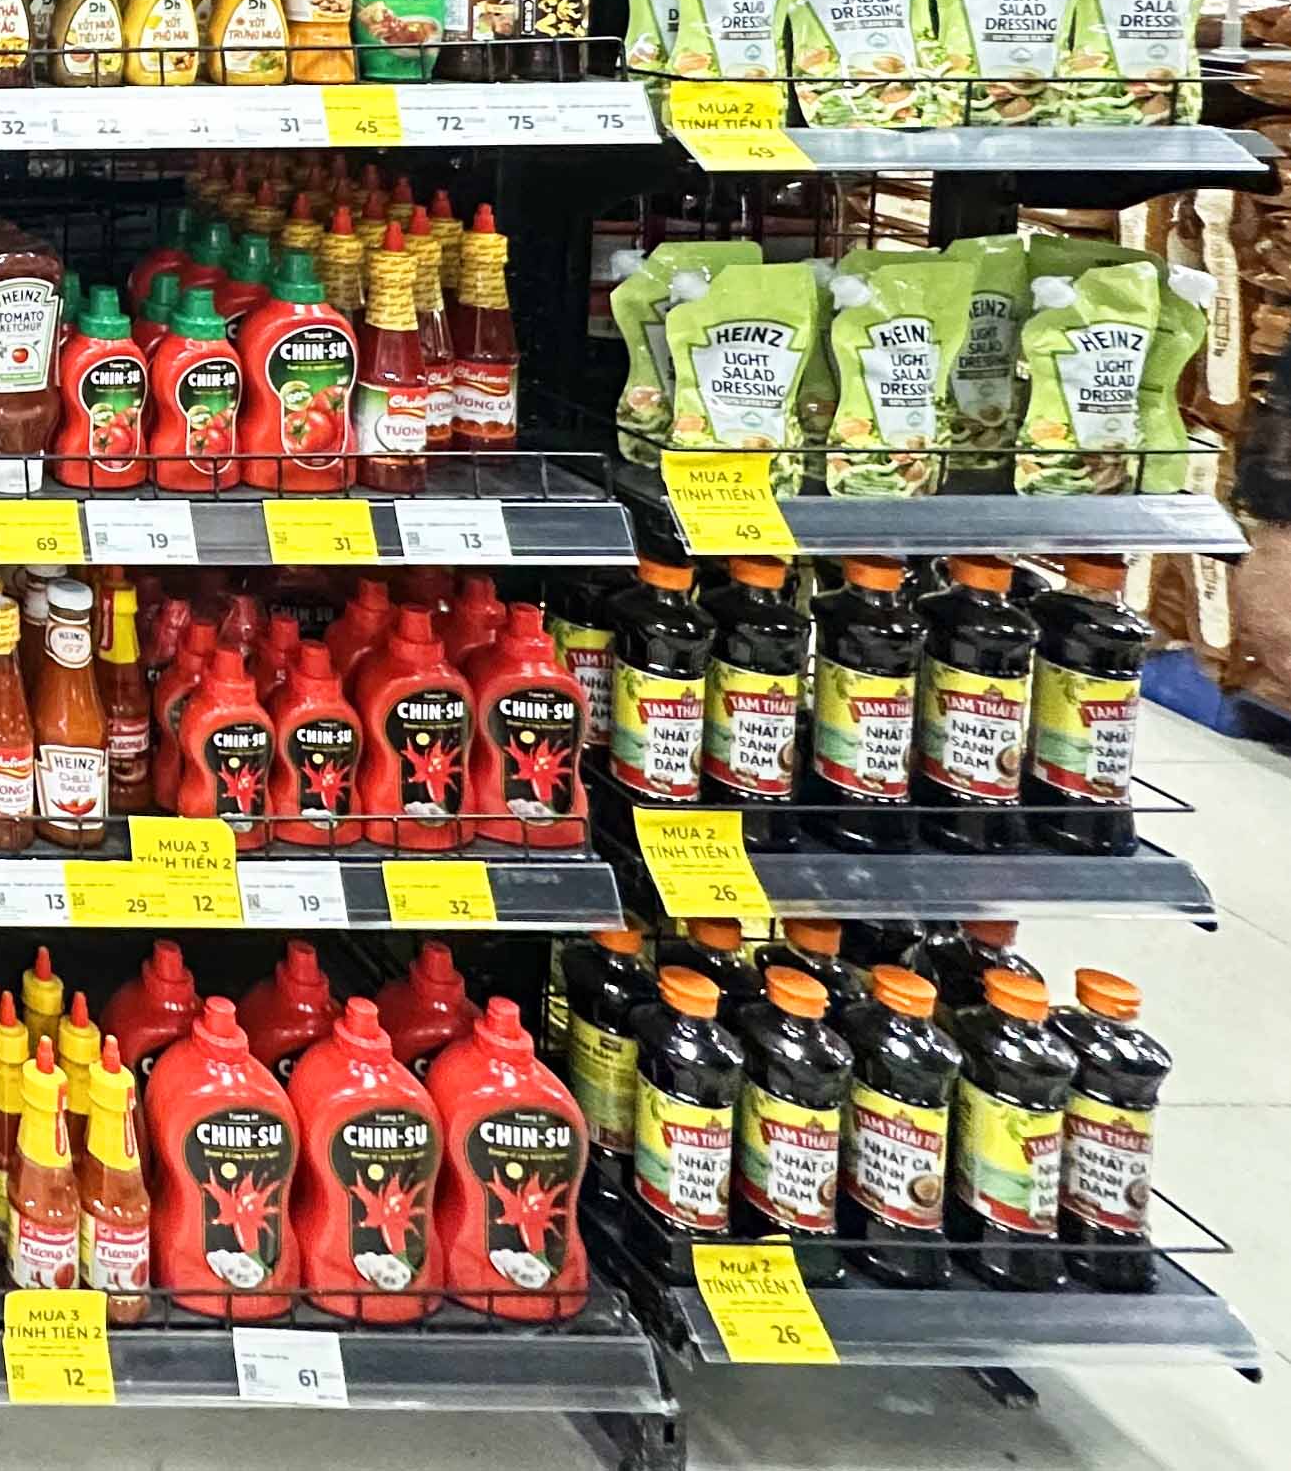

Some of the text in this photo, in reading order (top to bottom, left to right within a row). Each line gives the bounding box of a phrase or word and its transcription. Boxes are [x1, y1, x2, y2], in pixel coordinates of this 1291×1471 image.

[999, 2, 1046, 16] SALAD
[986, 17, 1056, 30] DRESSING
[355, 121, 378, 133] 45
[437, 116, 464, 131] 72
[508, 116, 534, 130] 75
[748, 147, 775, 158] 49
[1, 290, 41, 305] HEINZ
[717, 327, 783, 347] HEINZ
[280, 341, 348, 362] CHIN-SU
[724, 353, 769, 367] LIGHT
[91, 369, 140, 386] CHIN-SU
[188, 371, 235, 387] CHIN-SU
[722, 366, 774, 381] SALAD
[711, 380, 785, 397] DRESSING
[689, 471, 742, 484] MUA 2
[673, 486, 714, 502] TÍNH
[759, 487, 765, 499] 1
[736, 525, 761, 540] 49
[37, 537, 57, 551] 69
[460, 533, 482, 549] 13
[397, 701, 463, 720] CHIN-SU
[499, 699, 574, 720] CHIN-SU
[54, 755, 95, 773] HEINZ
[661, 827, 715, 841] MUA 2
[710, 885, 737, 901] 26
[449, 900, 470, 915] 32
[196, 1123, 282, 1147] CHIN-SU
[344, 1125, 427, 1147] CHIN-SU
[480, 1123, 569, 1147] CHIN-SU
[28, 1309, 80, 1322] MUA 3
[8, 1326, 45, 1341] TÍNH
[94, 1326, 101, 1339] 2
[773, 1325, 801, 1344] 26
[64, 1369, 85, 1386] 12
[298, 1369, 318, 1387] 61
